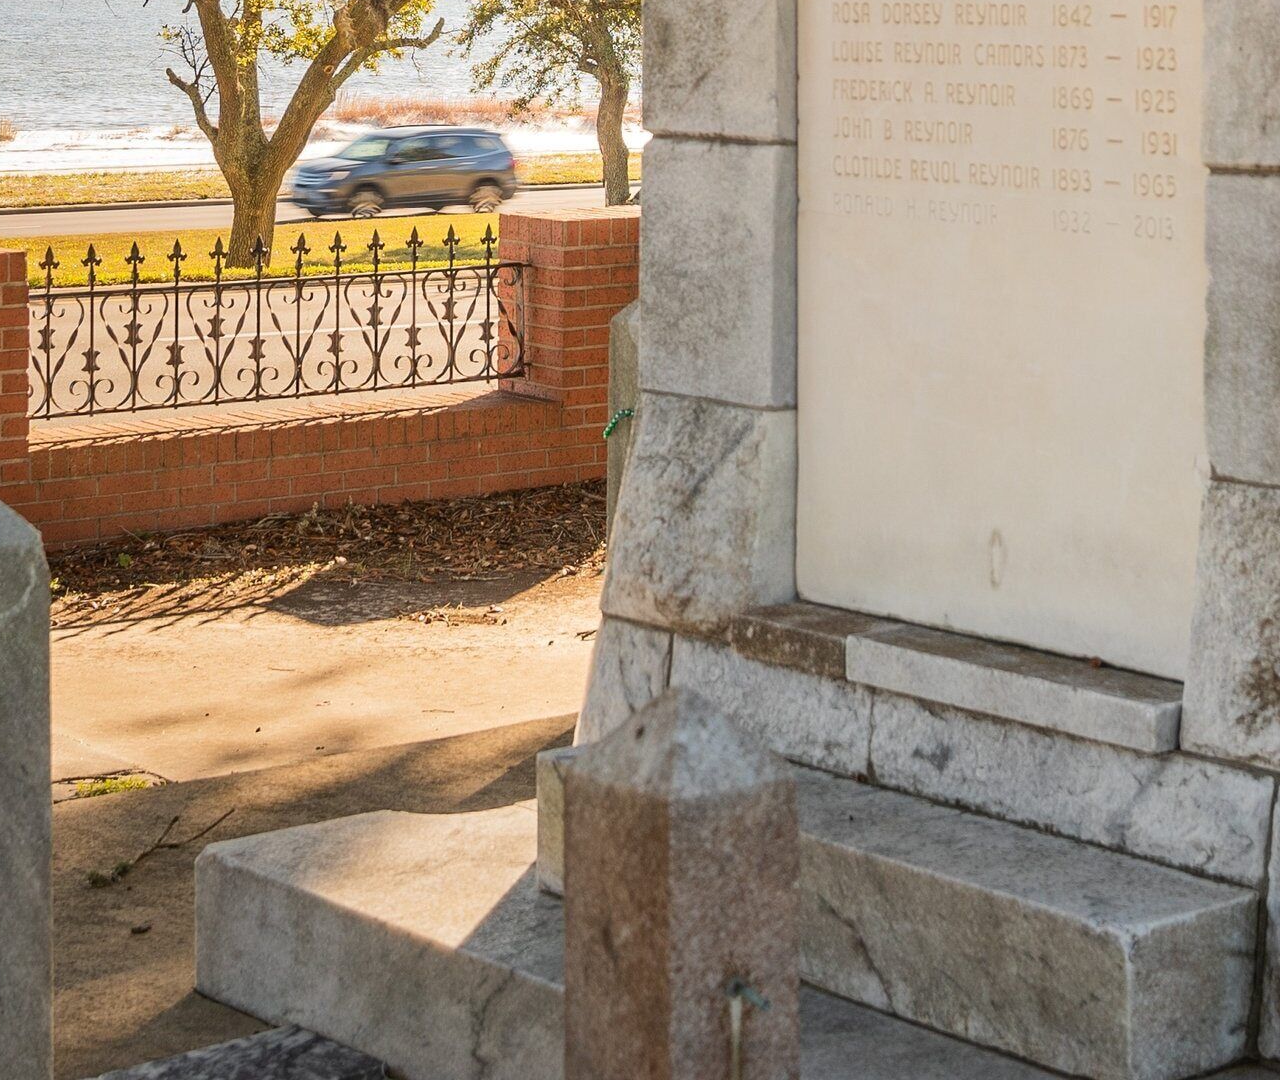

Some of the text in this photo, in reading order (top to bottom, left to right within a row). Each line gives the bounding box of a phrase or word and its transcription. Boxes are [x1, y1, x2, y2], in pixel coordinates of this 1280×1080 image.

[832, 0, 871, 26] ROSA
[881, 1, 943, 26] DORSEY
[954, 2, 1028, 28] REYNOIR
[1051, 3, 1093, 29] 1842
[1143, 3, 1178, 30] 1917
[831, 39, 884, 64] LOUISE
[893, 40, 963, 67] REYNOIR
[973, 42, 1045, 69] CAMORS
[1051, 44, 1089, 70] 1873
[1136, 45, 1178, 73] 1923
[832, 77, 914, 105] FREDERICK
[945, 81, 1016, 108] REYNOIR
[1051, 85, 1094, 112] 1869
[1134, 88, 1178, 115] 1925
[832, 115, 873, 140] JOHN
[903, 119, 974, 145] REYNOIR
[1051, 126, 1090, 153] 1876
[1141, 130, 1178, 158] 1931
[832, 154, 903, 181] CLOTILDE
[909, 158, 962, 185] REVOL
[968, 162, 1041, 190] REYNOIR
[1051, 167, 1093, 194] 1893
[1132, 171, 1178, 200] 1965
